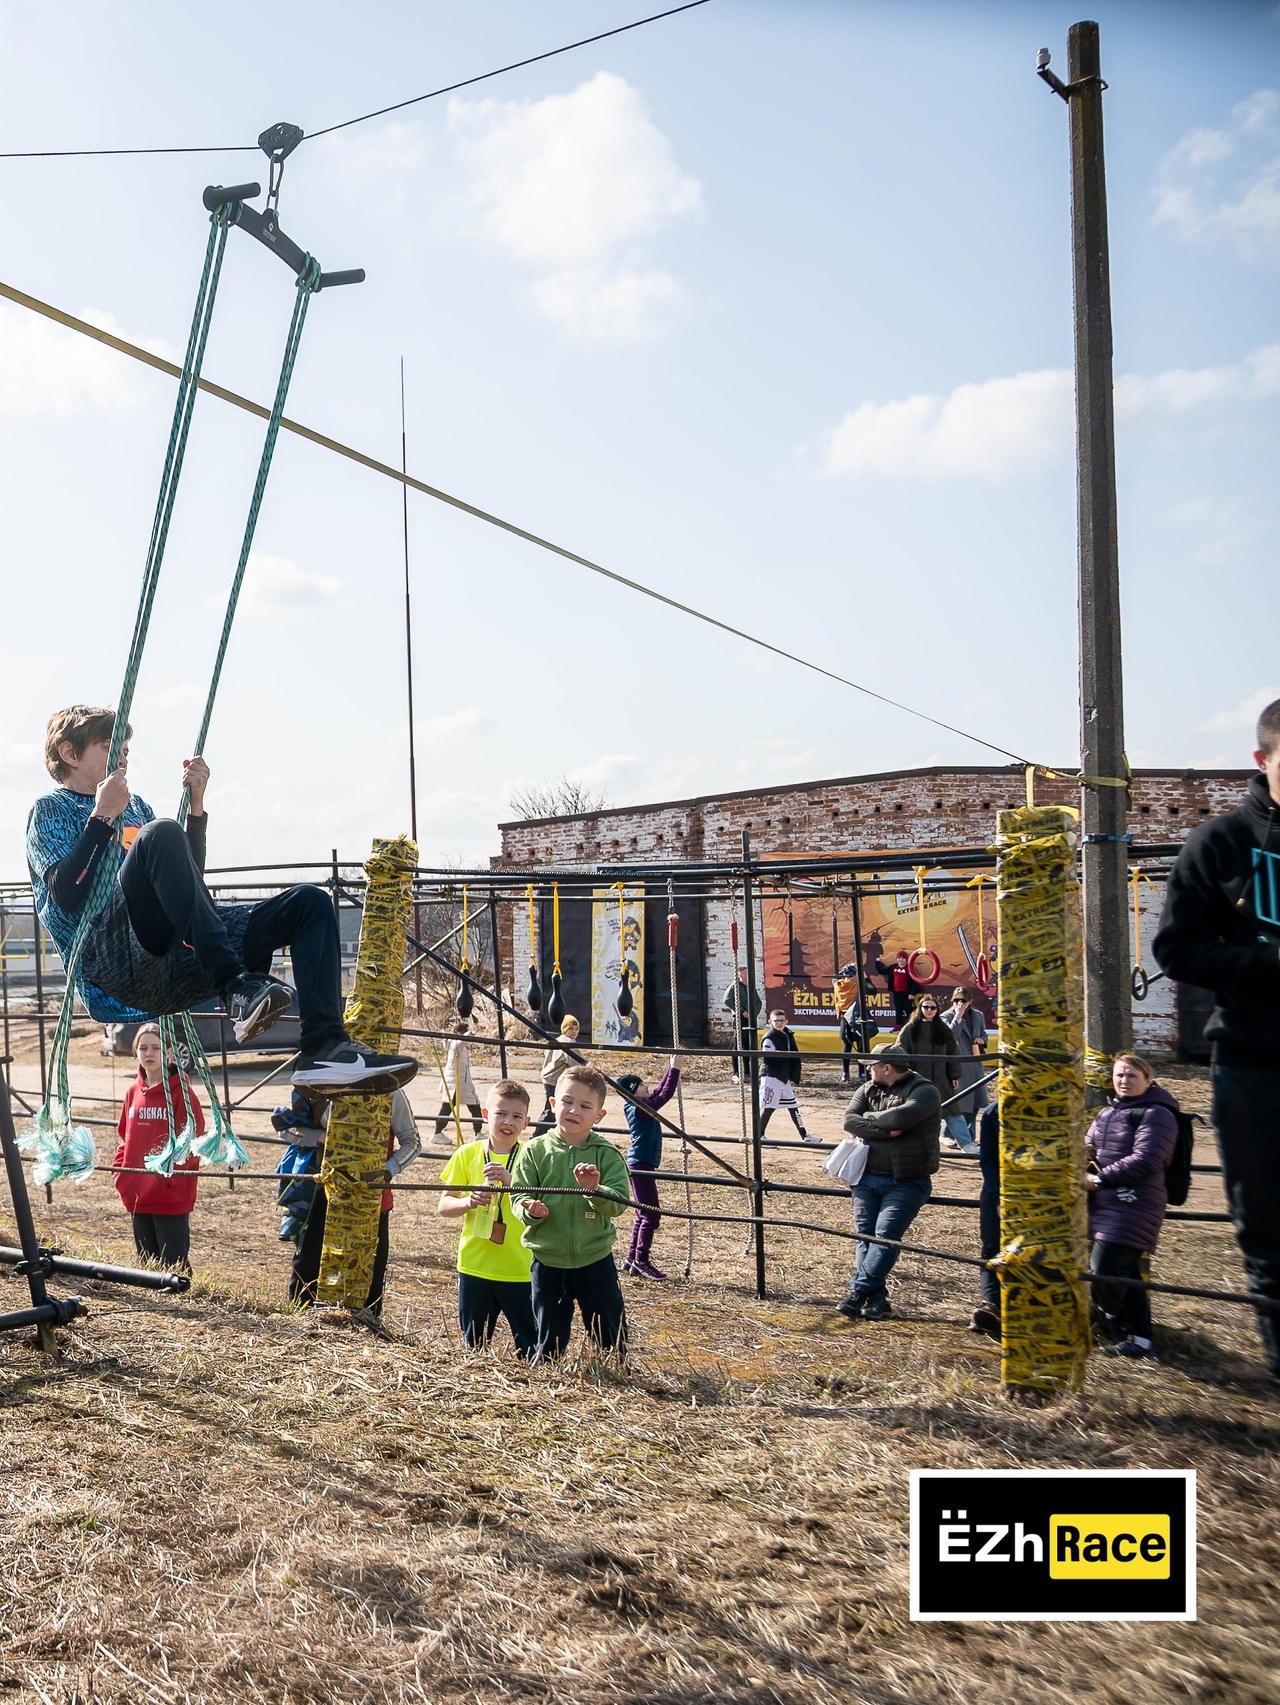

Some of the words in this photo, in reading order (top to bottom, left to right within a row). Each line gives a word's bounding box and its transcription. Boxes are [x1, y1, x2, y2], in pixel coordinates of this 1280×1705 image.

[897, 904, 929, 915] EXTREE
[929, 900, 947, 909] RACE
[793, 1008, 838, 1016] ЭКСТРЕМАЛЬН
[875, 1009, 897, 1017] ПРЕПЯ
[138, 1106, 168, 1120] SIGNAL
